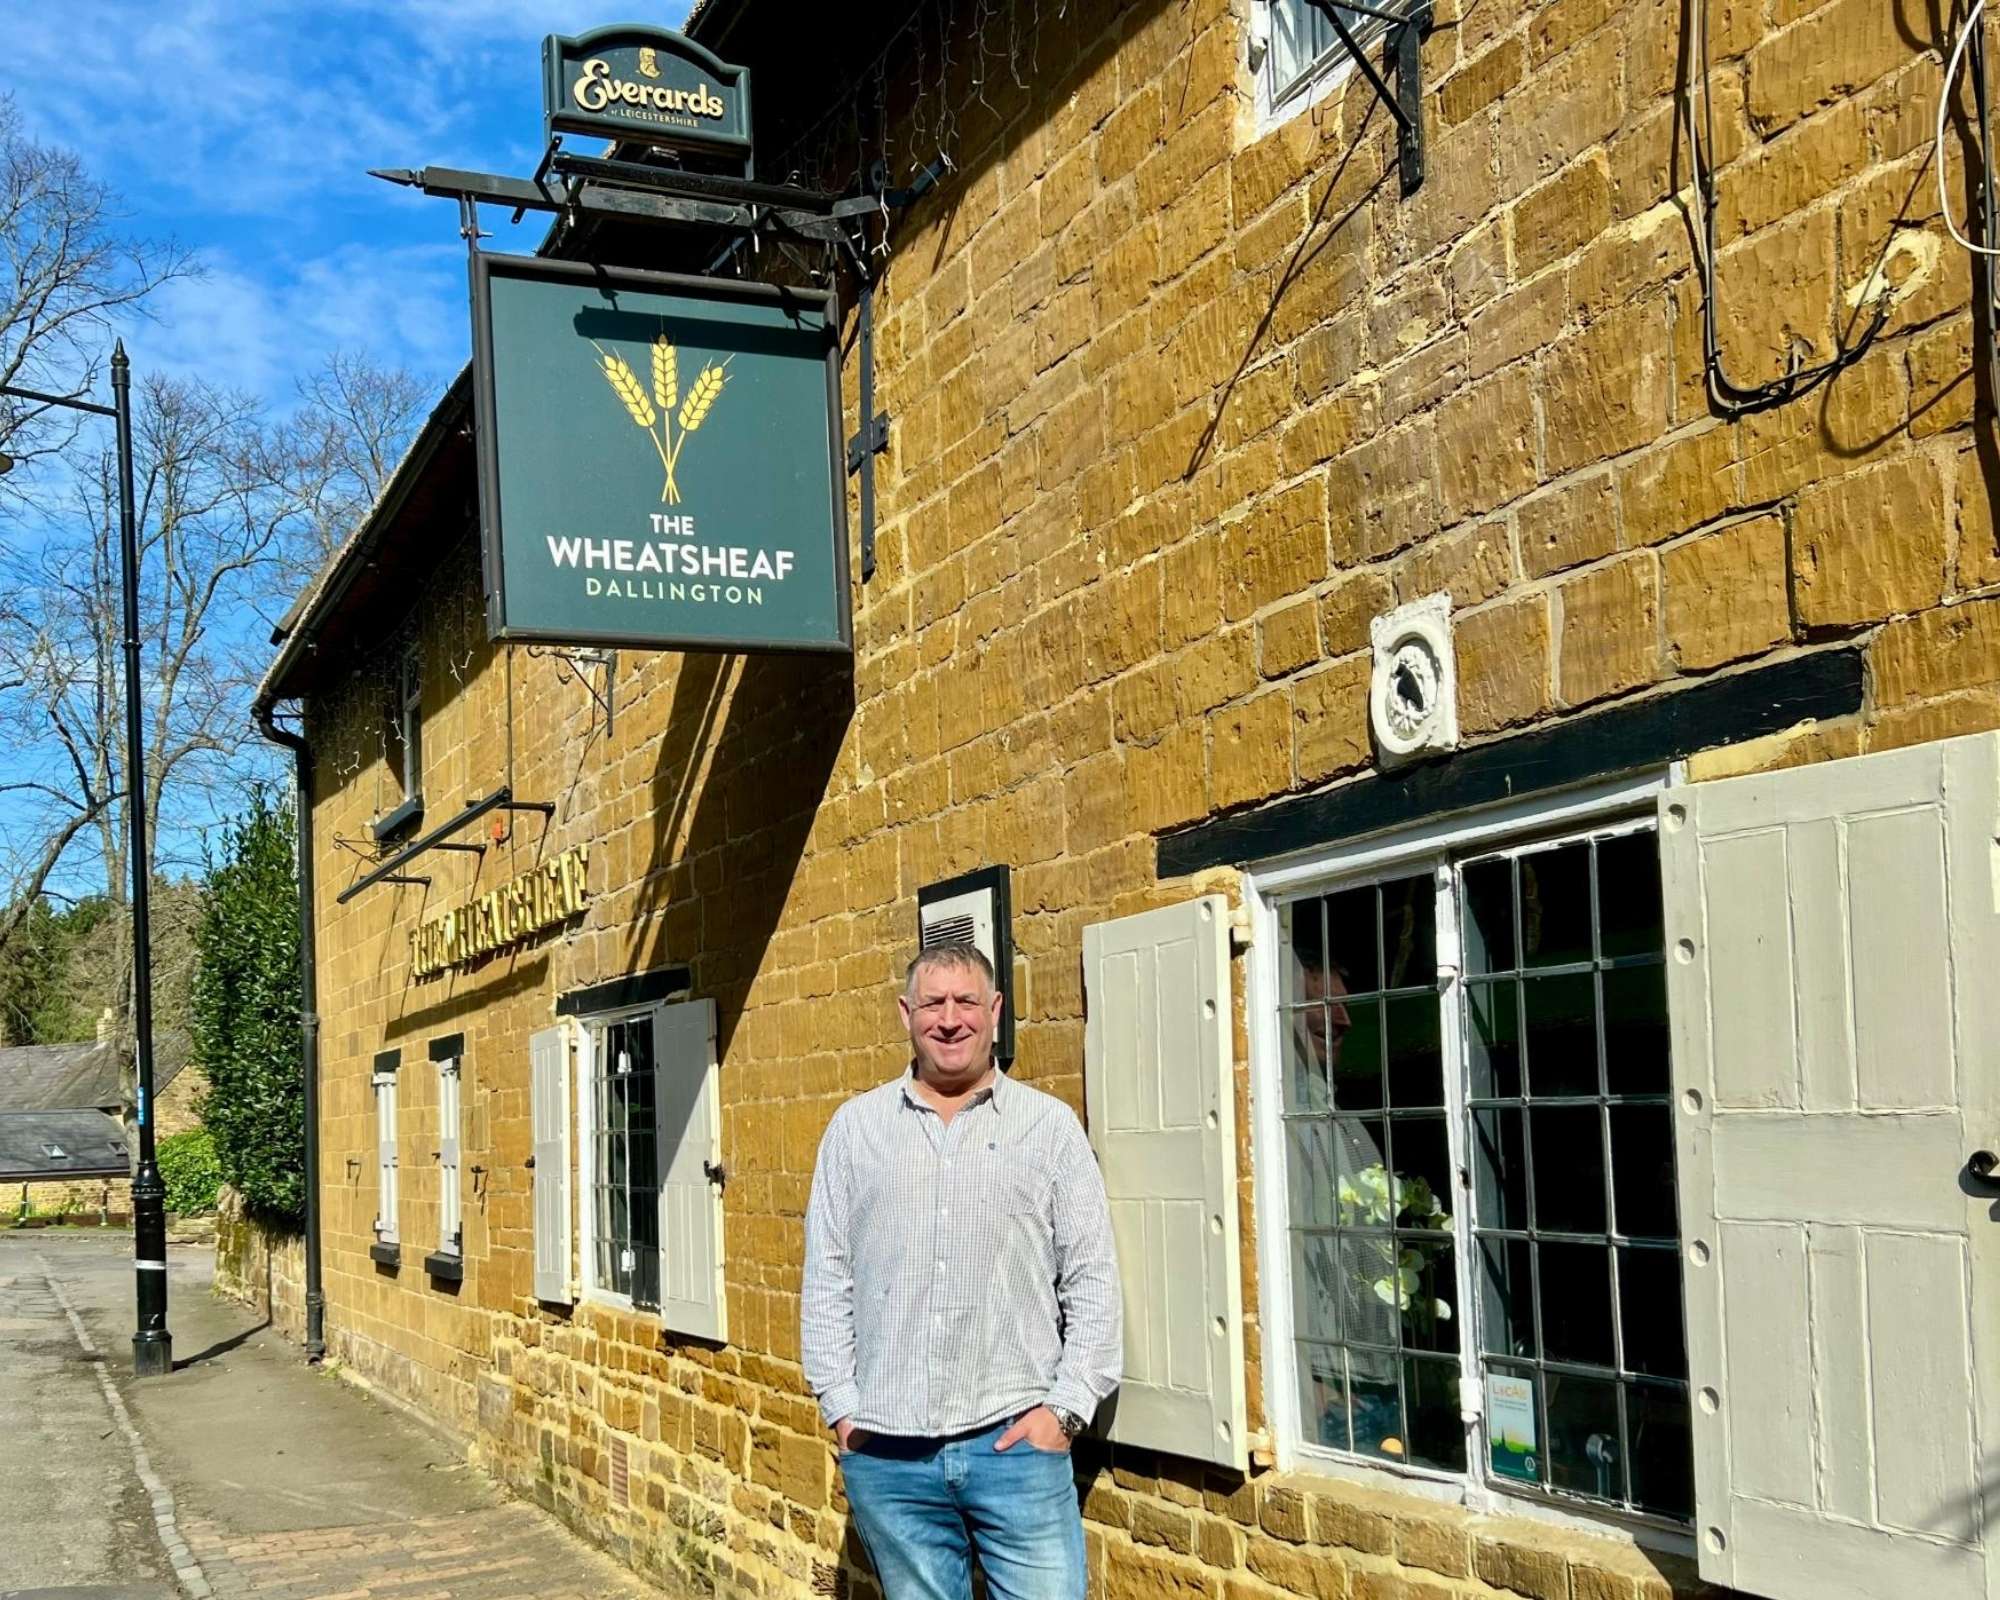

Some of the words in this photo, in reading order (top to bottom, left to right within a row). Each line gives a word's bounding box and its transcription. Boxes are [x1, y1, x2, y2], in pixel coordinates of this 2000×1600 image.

[573, 58, 724, 117] Everards
[620, 108, 699, 128] LEICESTERSHIRE
[649, 513, 695, 536] THE
[546, 535, 795, 580] WHEATSHEAF
[586, 577, 763, 605] DALLINGTON
